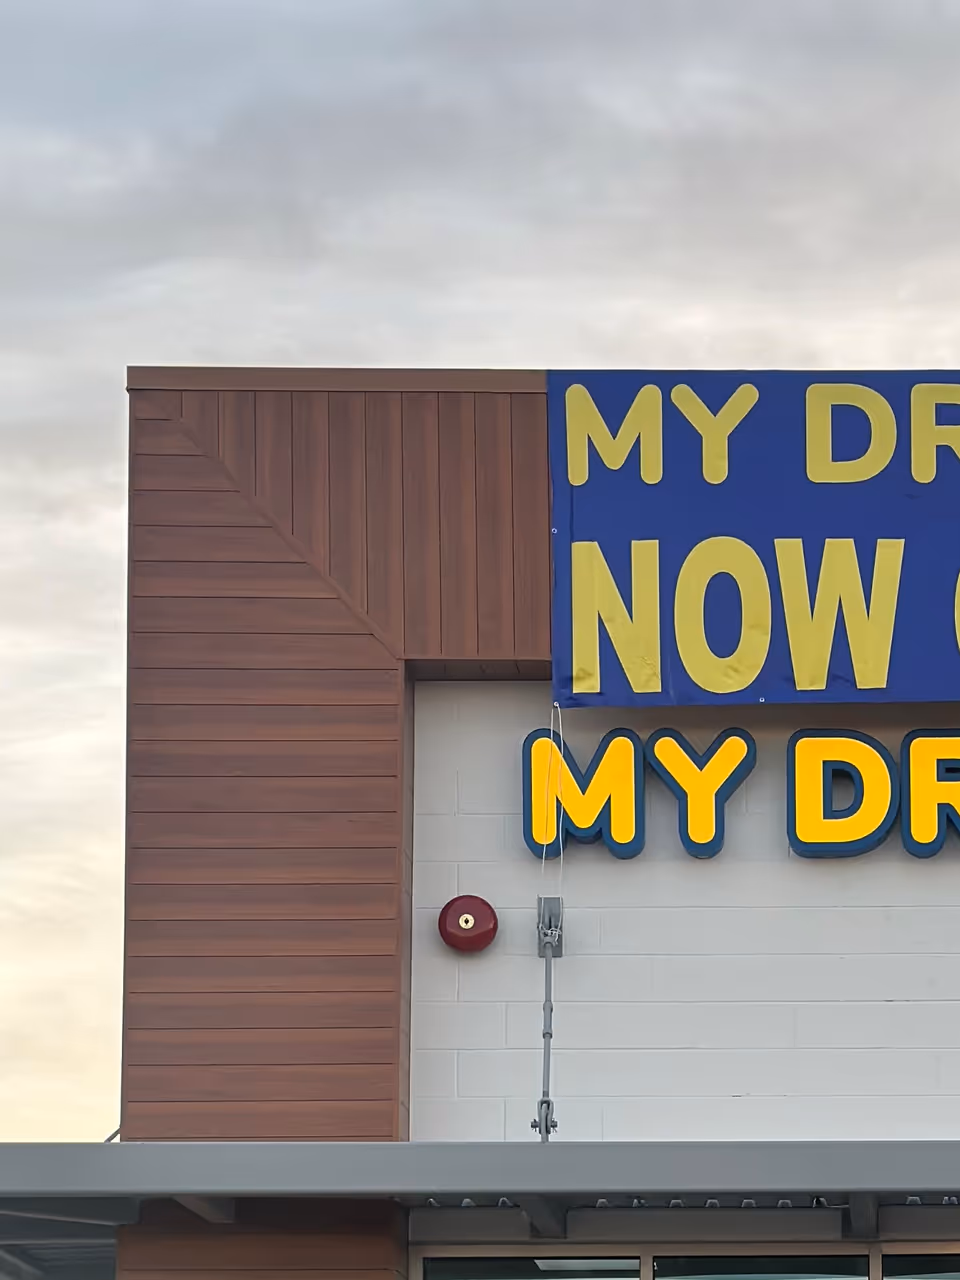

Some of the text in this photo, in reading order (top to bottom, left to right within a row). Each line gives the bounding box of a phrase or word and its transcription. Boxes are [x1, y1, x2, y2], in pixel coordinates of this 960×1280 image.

[565, 383, 760, 485] MY
[570, 536, 905, 694] NOW
[523, 726, 757, 859] MY
